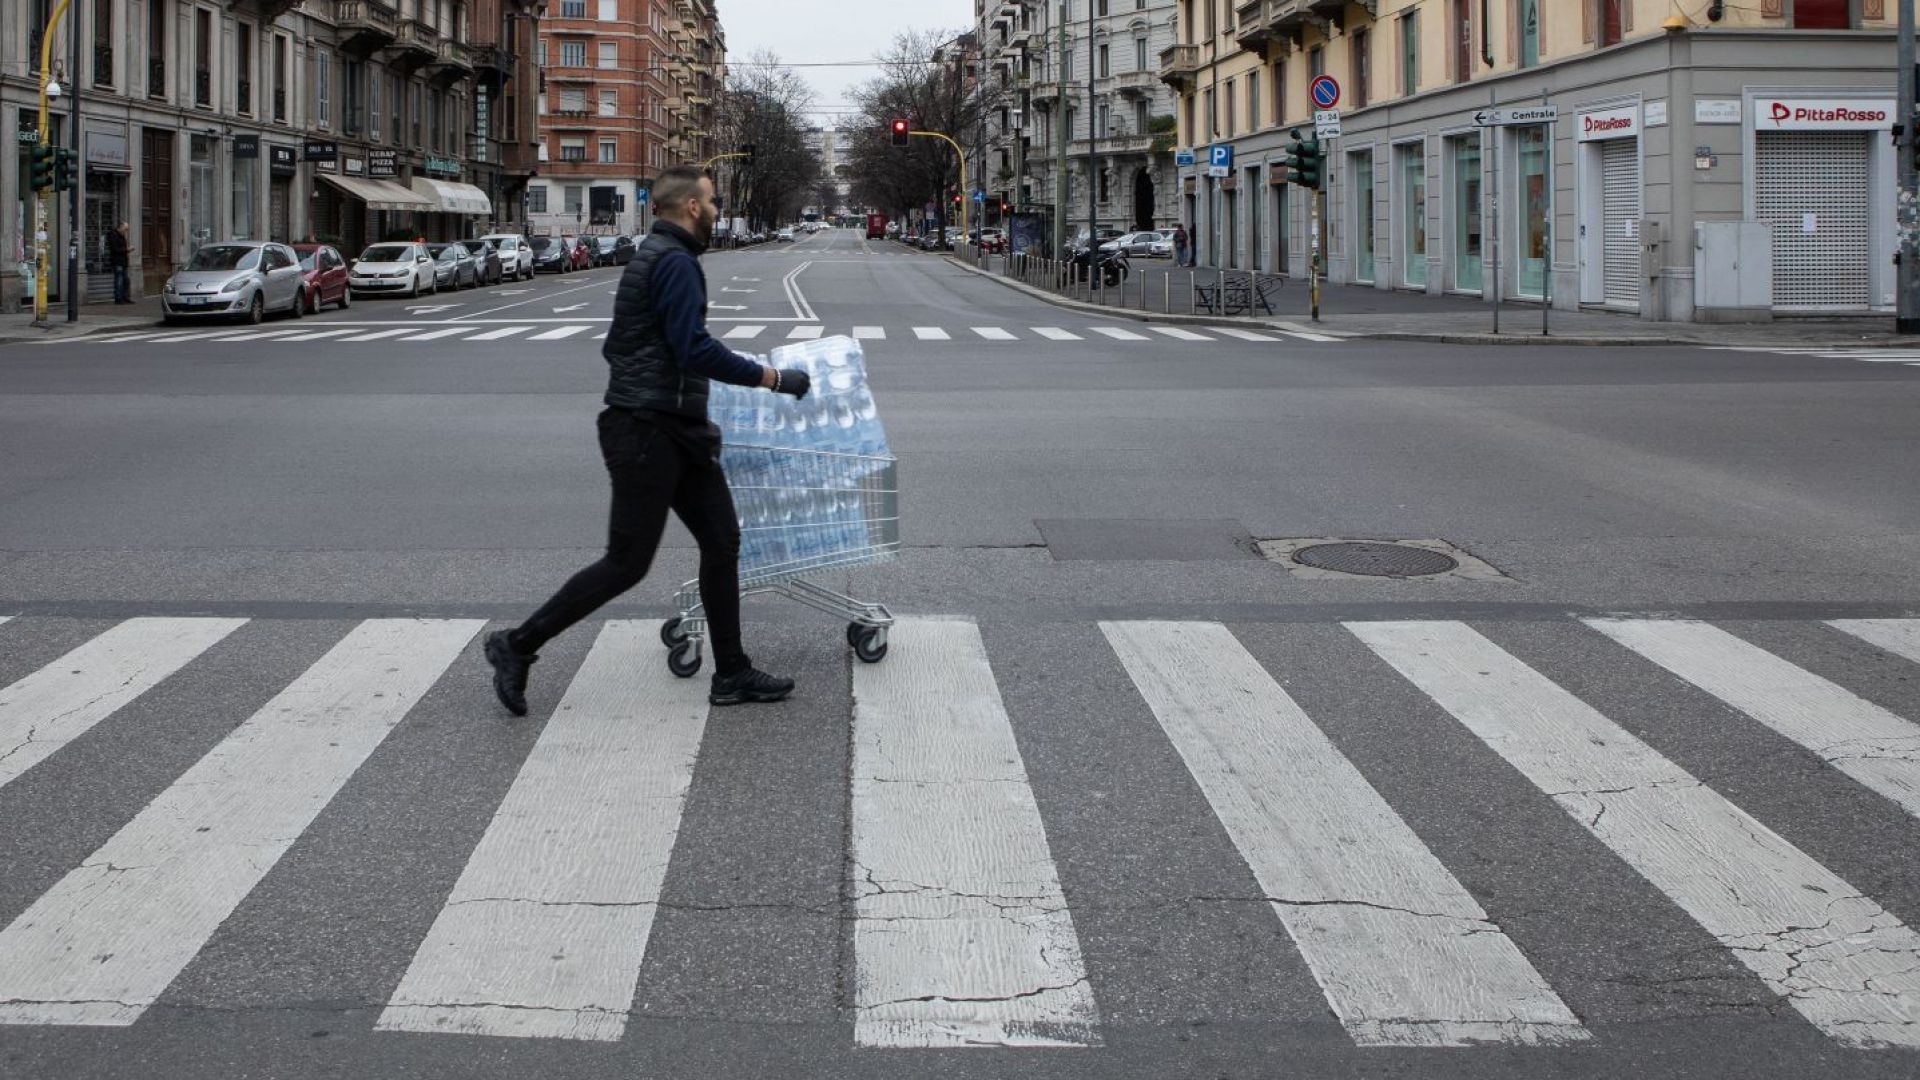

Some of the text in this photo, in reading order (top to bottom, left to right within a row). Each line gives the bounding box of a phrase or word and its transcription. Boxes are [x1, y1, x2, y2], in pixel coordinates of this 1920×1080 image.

[1512, 109, 1555, 120] Centrale
[1795, 108, 1886, 121] PittaRosso
[1594, 117, 1632, 131] PittaRosso
[1213, 147, 1226, 164] P
